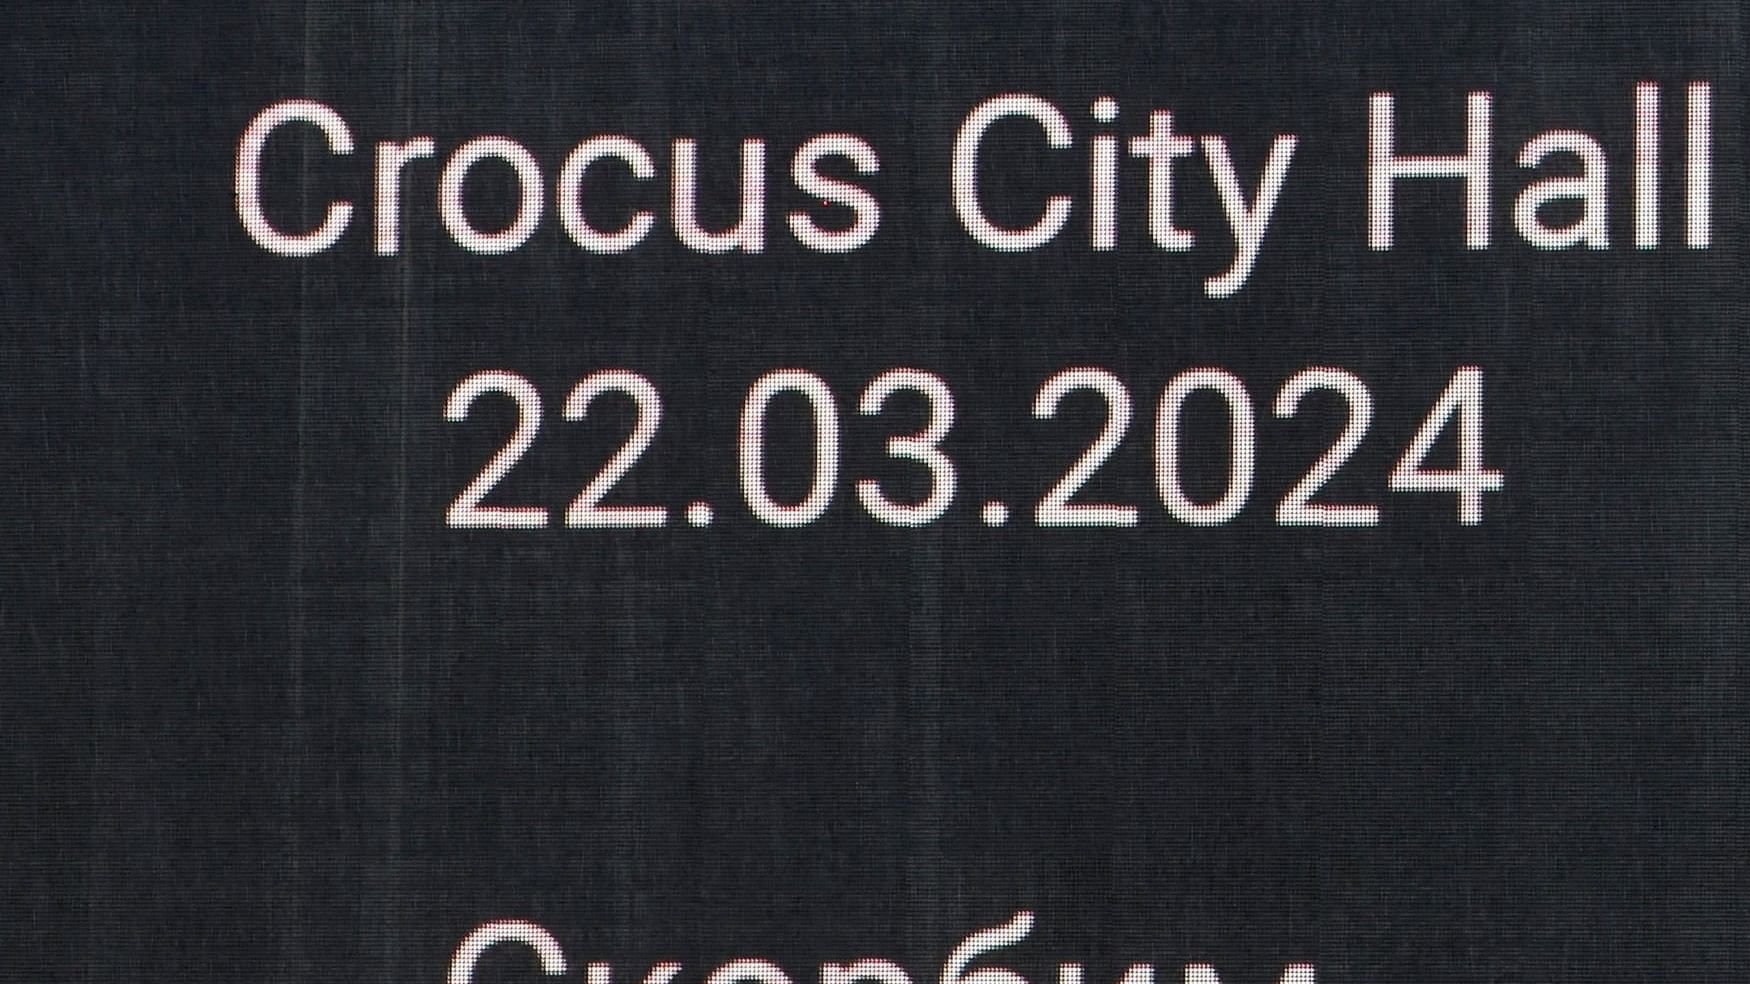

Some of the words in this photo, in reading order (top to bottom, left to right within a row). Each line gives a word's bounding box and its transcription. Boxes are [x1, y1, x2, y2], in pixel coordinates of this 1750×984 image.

[235, 100, 880, 257] Crocus
[951, 94, 1297, 298] City
[1368, 82, 1711, 250] Hall
[445, 367, 1504, 528] 22.03.2024
